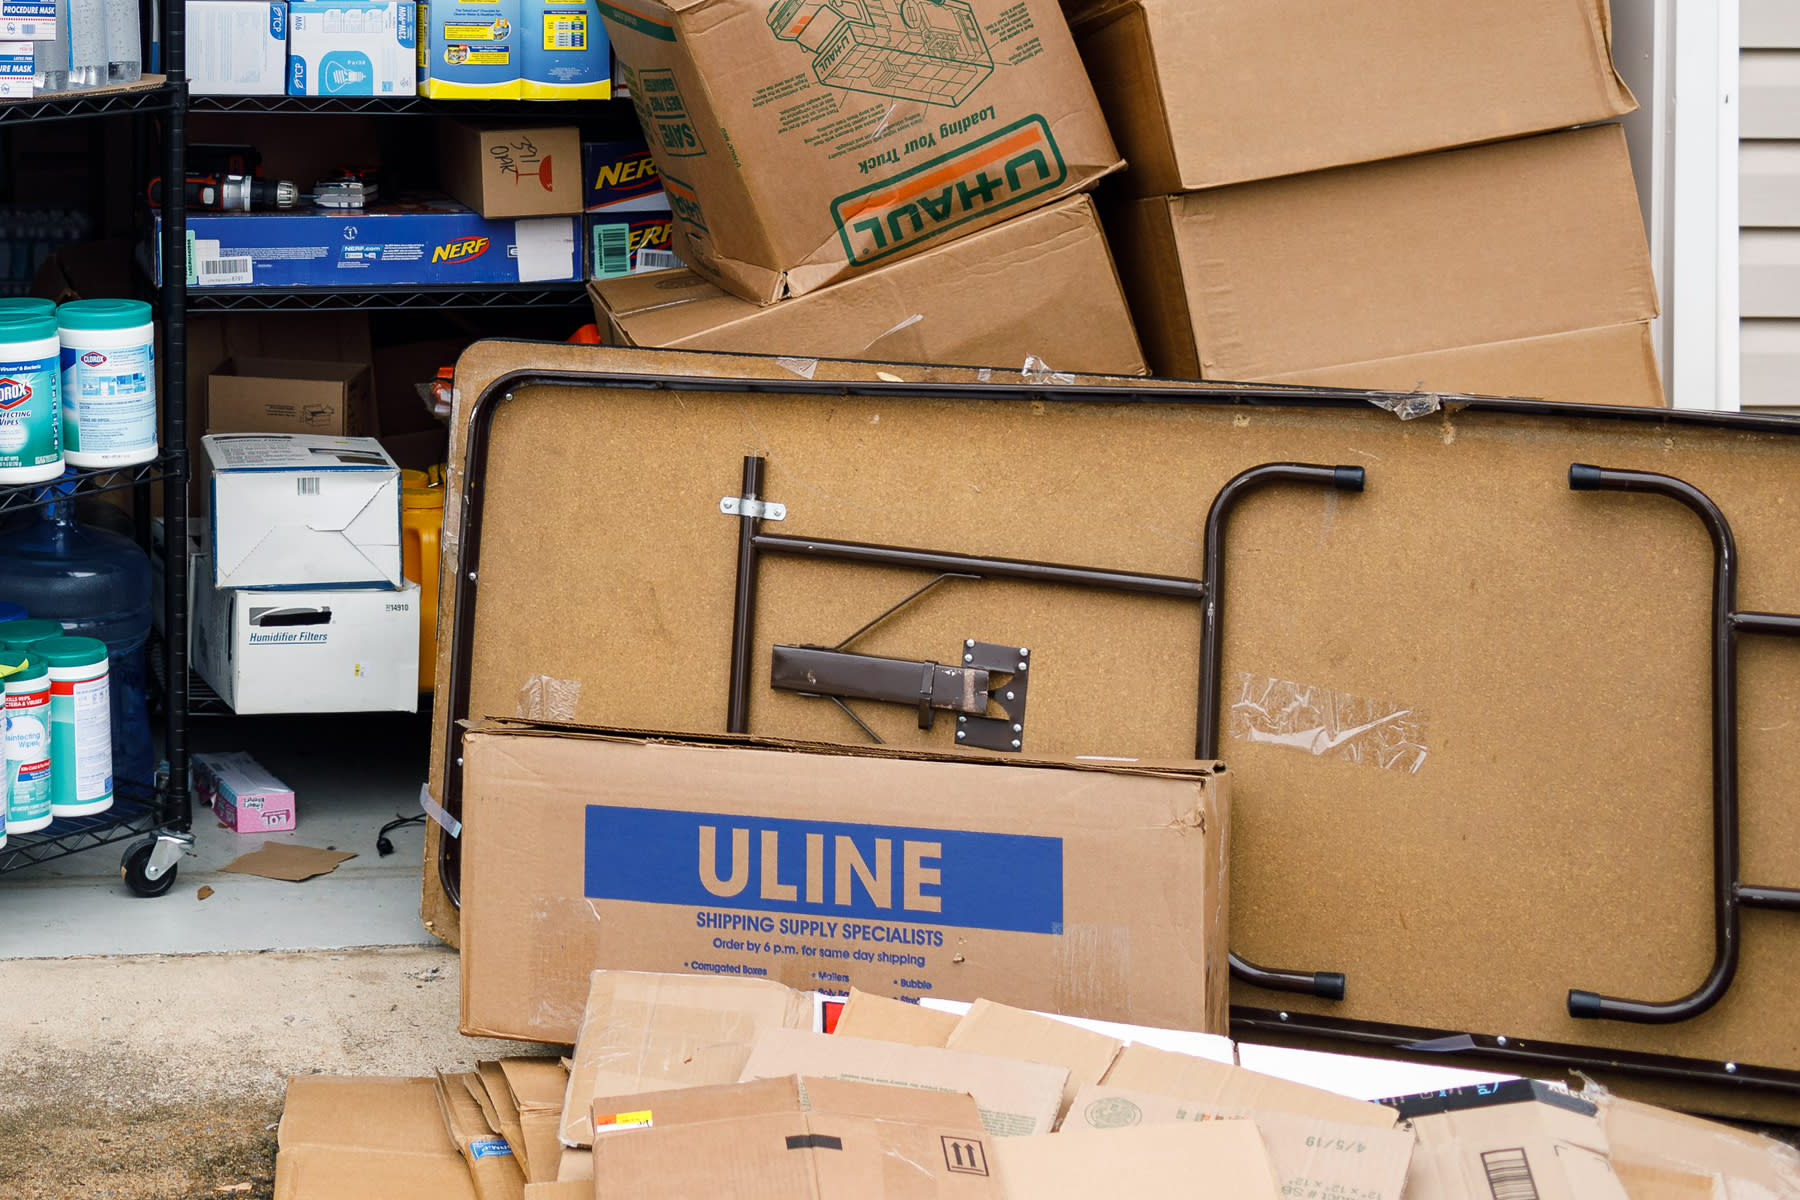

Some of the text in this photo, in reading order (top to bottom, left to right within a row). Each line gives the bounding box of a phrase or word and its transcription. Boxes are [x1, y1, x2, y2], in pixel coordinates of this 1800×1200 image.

[3, 5, 56, 14] PROCEDURE MASK
[272, 16, 282, 33] TCP
[398, 5, 407, 40] 23W=90W
[819, 33, 850, 76] U-HAUL
[13, 64, 33, 73] MASK
[294, 62, 303, 79] TCP
[664, 94, 684, 112] BEST
[939, 104, 997, 140] Loading
[903, 133, 938, 156] Your
[857, 150, 902, 175] Truck
[854, 147, 1052, 250] U-HAUL
[431, 236, 490, 263] NERF
[390, 603, 409, 612] 14910
[249, 631, 328, 643] Humidifier Filters
[698, 825, 942, 913] ULINE
[696, 911, 944, 947] SHIPPING SUPPLY SPECIALISTS
[712, 937, 926, 968] Order by 6 p.m. for same day shipping
[690, 960, 768, 976] Corrugated Boxes
[818, 971, 850, 983] Mailers
[900, 978, 932, 990] Bubble
[1304, 1136, 1367, 1154] 4/5/19
